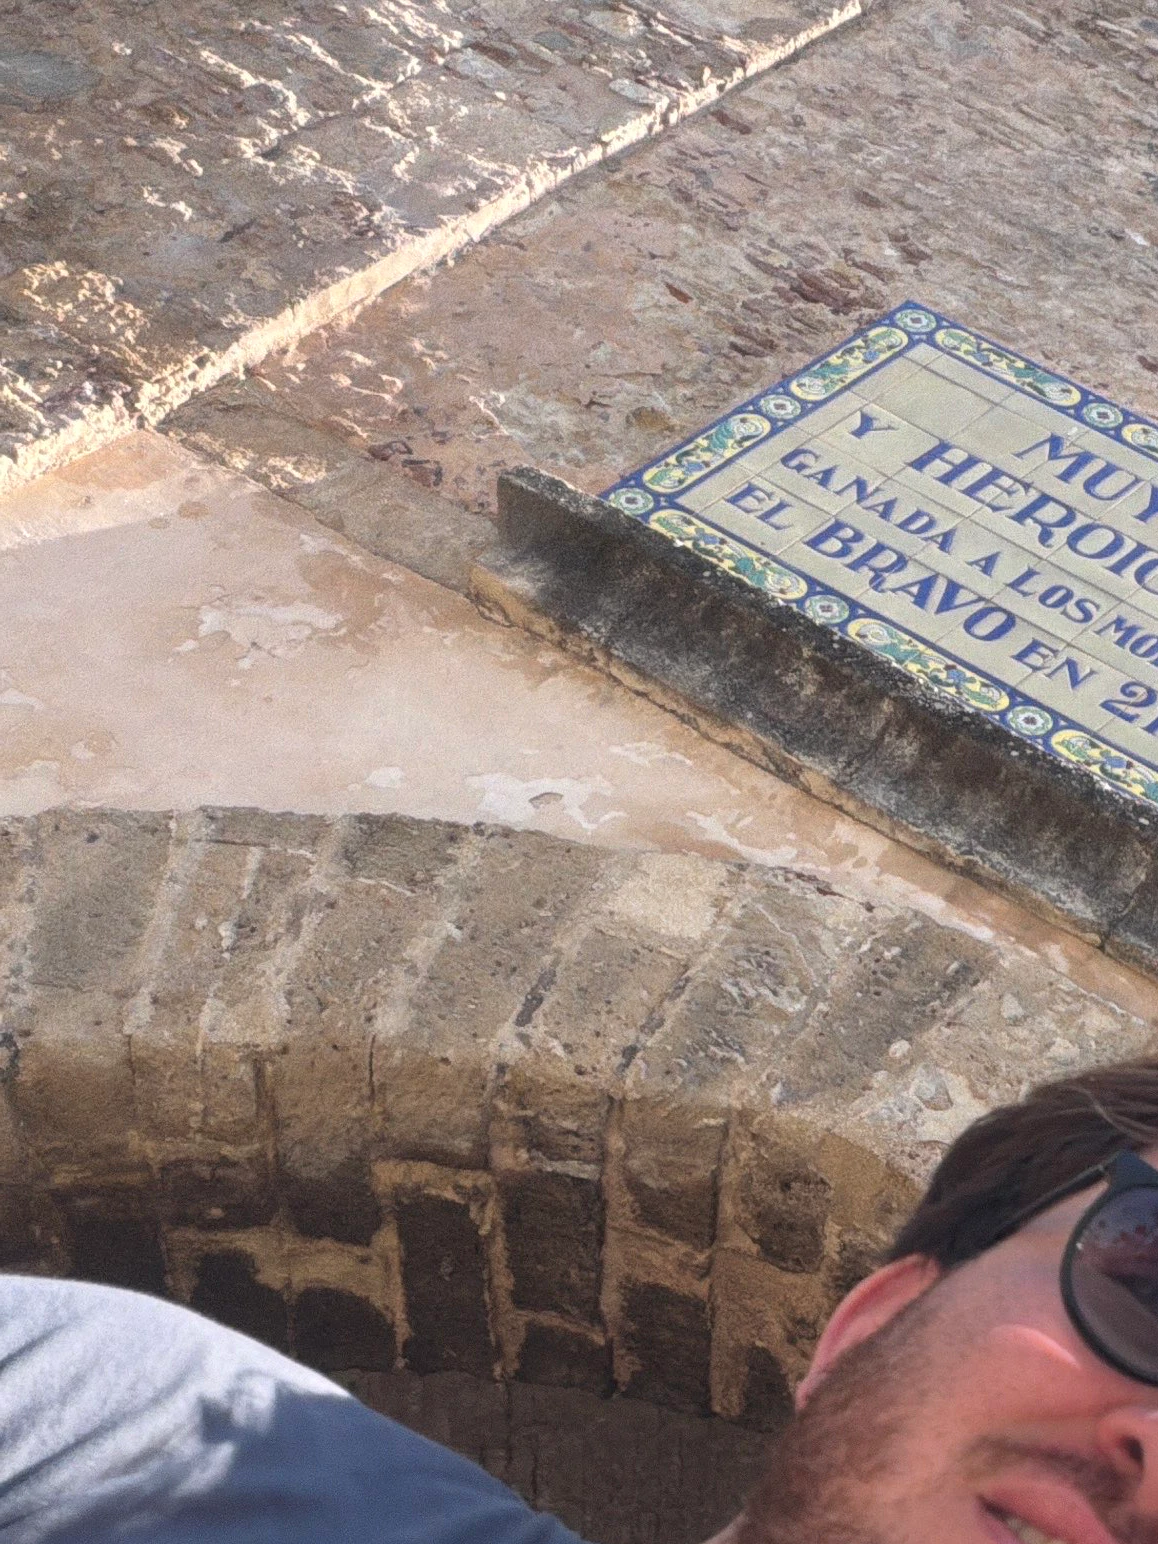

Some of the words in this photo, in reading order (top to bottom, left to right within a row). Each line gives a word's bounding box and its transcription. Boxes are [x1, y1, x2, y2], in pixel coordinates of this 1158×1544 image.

[849, 410, 899, 440] Y
[723, 481, 794, 531] EL
[802, 518, 1017, 642] BRAVO
[1010, 637, 1099, 690] EN
[780, 447, 957, 555] GANADA
[965, 551, 1000, 578] A
[1003, 565, 1099, 624] LOS
